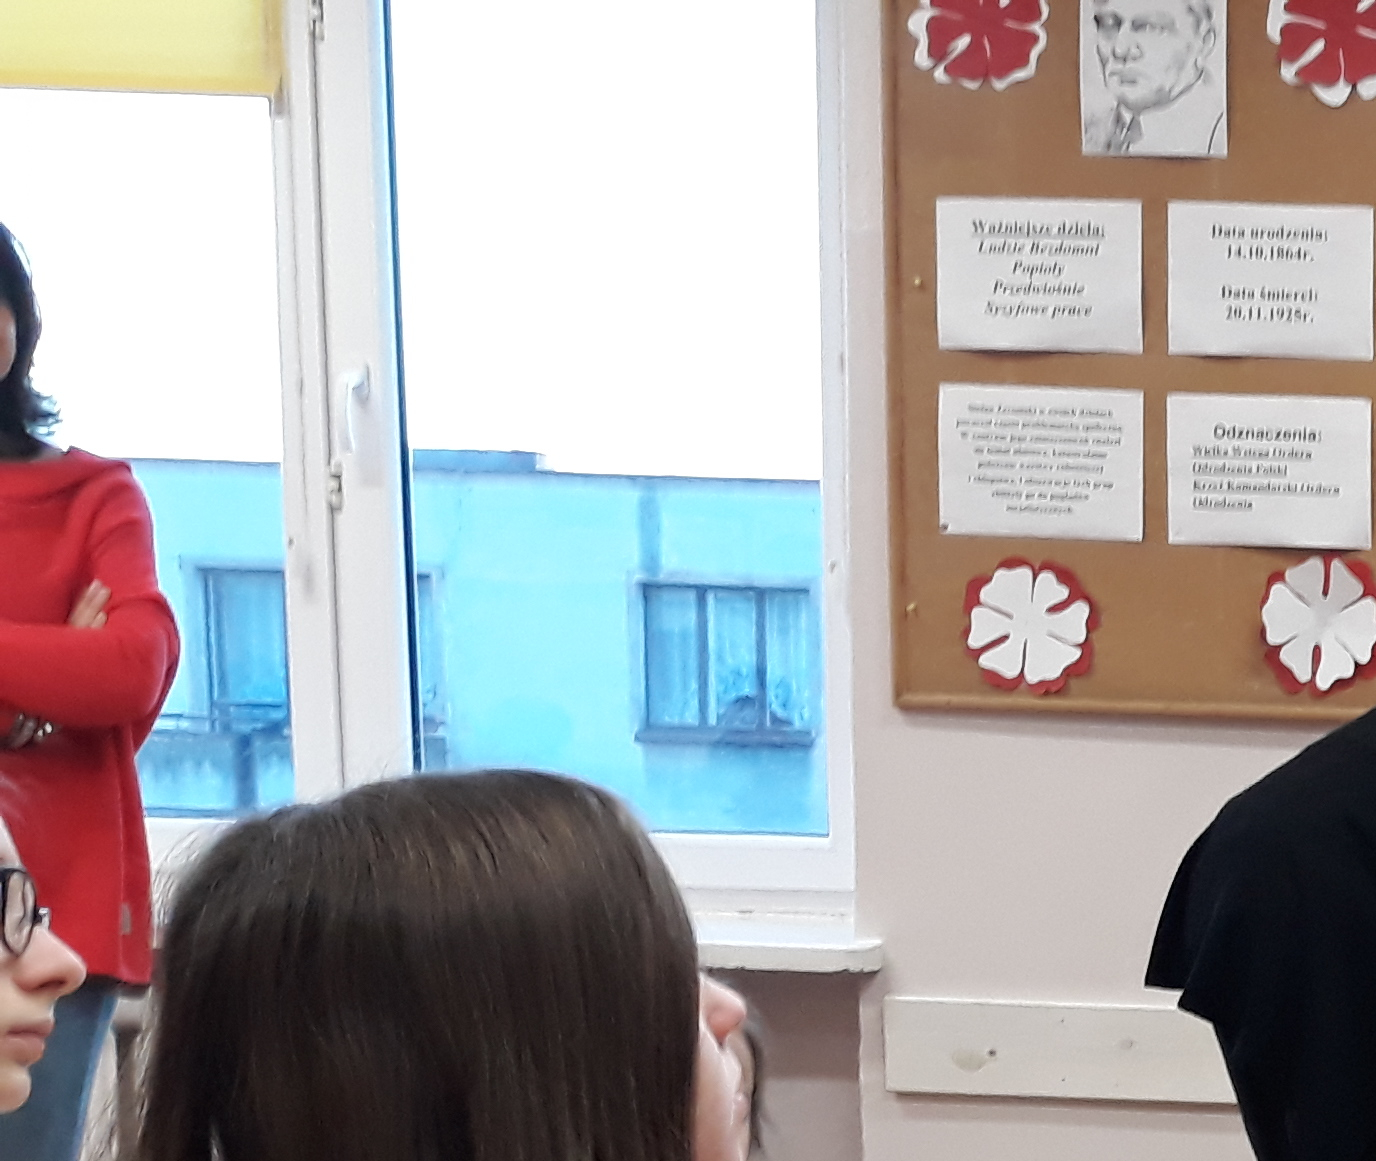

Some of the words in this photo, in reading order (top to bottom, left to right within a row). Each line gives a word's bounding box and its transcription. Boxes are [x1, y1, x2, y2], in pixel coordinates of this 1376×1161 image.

[1211, 223, 1246, 240] Data
[1221, 285, 1256, 301] Data
[1213, 423, 1322, 443] Odznaczenia:
